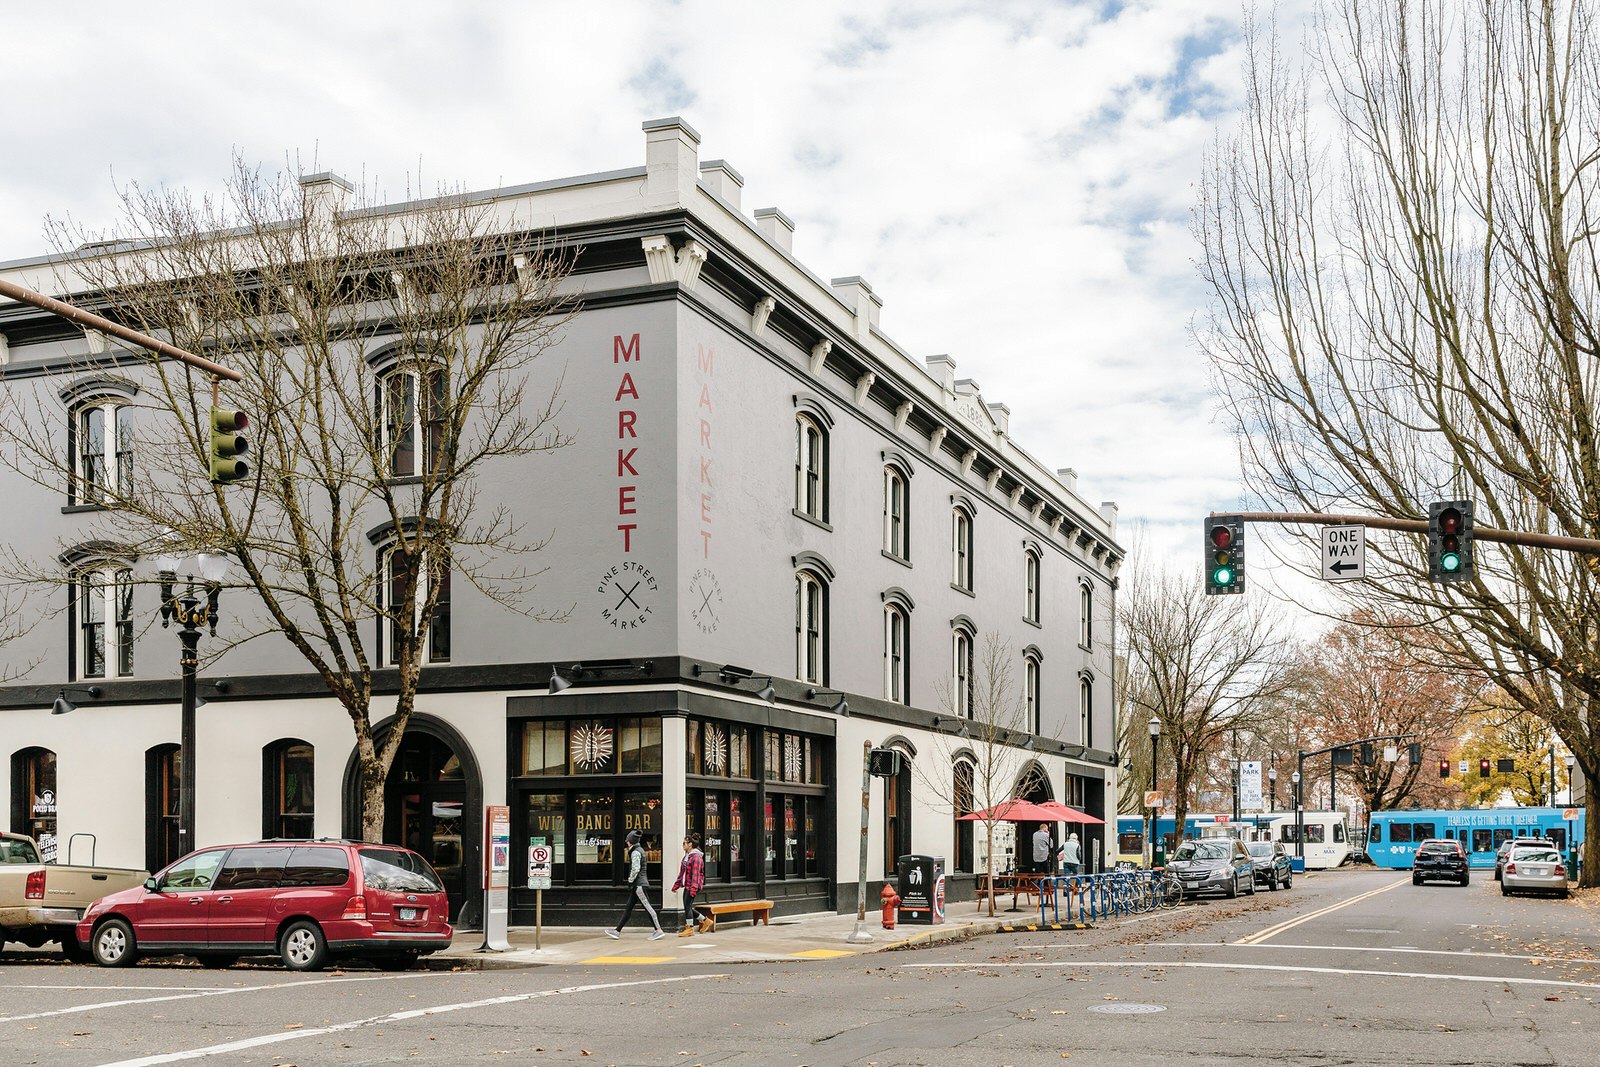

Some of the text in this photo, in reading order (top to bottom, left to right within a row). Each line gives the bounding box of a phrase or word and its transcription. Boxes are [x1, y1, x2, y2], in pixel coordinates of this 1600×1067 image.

[613, 333, 640, 553] MARKET
[697, 342, 713, 560] MARKET
[1329, 530, 1358, 543] ONE
[1328, 544, 1359, 557] WAY
[597, 561, 658, 594] PINE STREET
[689, 569, 702, 594] PINE
[602, 606, 653, 630] MARKET
[691, 609, 721, 635] MARKET
[538, 813, 652, 831] WIZ BANG BAR
[687, 814, 741, 831] IZ ANG AR
